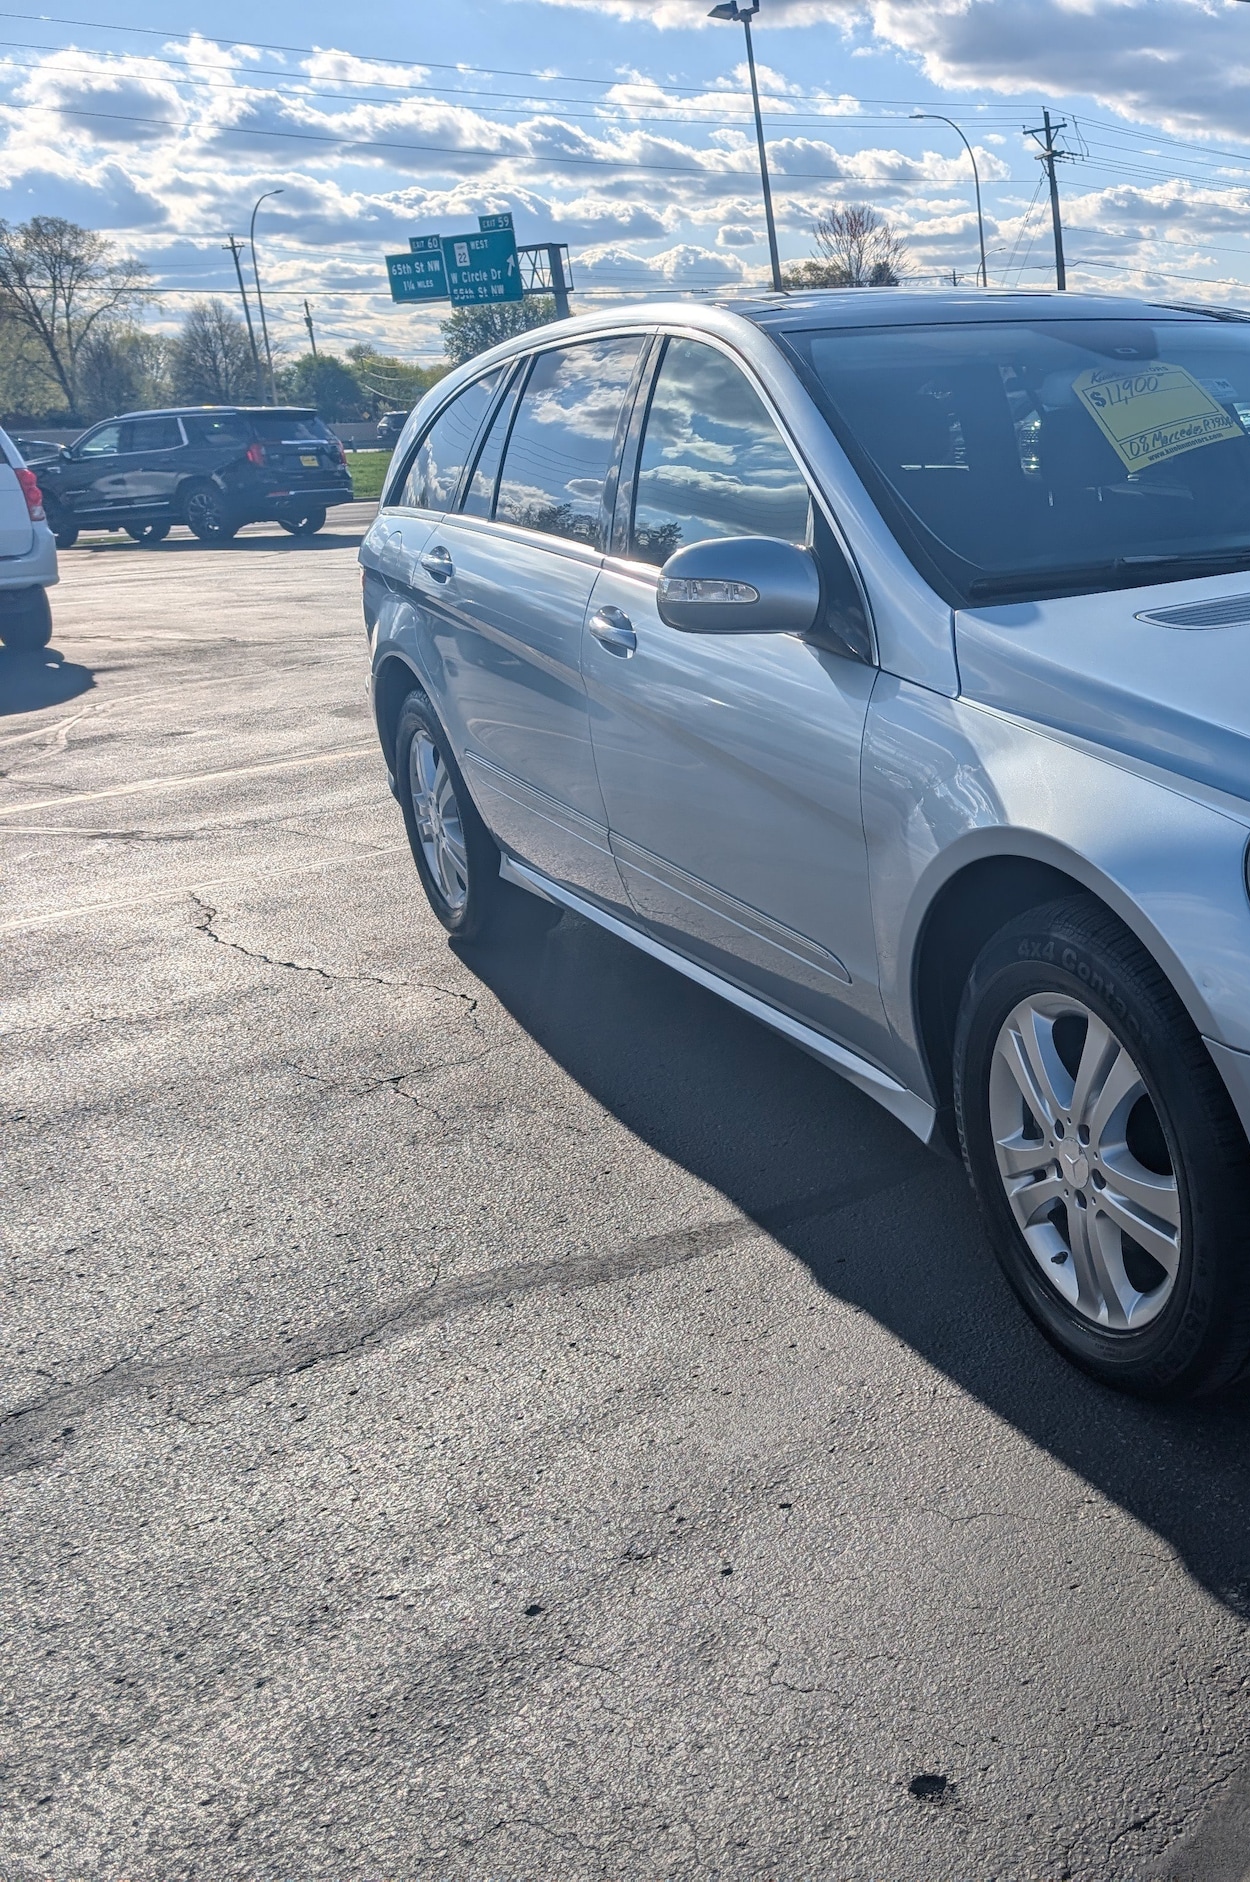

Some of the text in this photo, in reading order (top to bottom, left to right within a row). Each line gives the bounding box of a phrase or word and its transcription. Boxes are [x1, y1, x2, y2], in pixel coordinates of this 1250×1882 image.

[482, 216, 510, 229] EXIT 59
[412, 237, 438, 250] EXIT 60
[470, 239, 489, 250] WEST
[458, 252, 467, 264] 22
[391, 260, 440, 276] 65th St NW
[450, 268, 502, 284] W Circle Dr
[416, 279, 434, 289] MILES
[453, 284, 505, 300] 55th St NW
[1129, 435, 1150, 457] 08
[1017, 938, 1056, 960] 4x4
